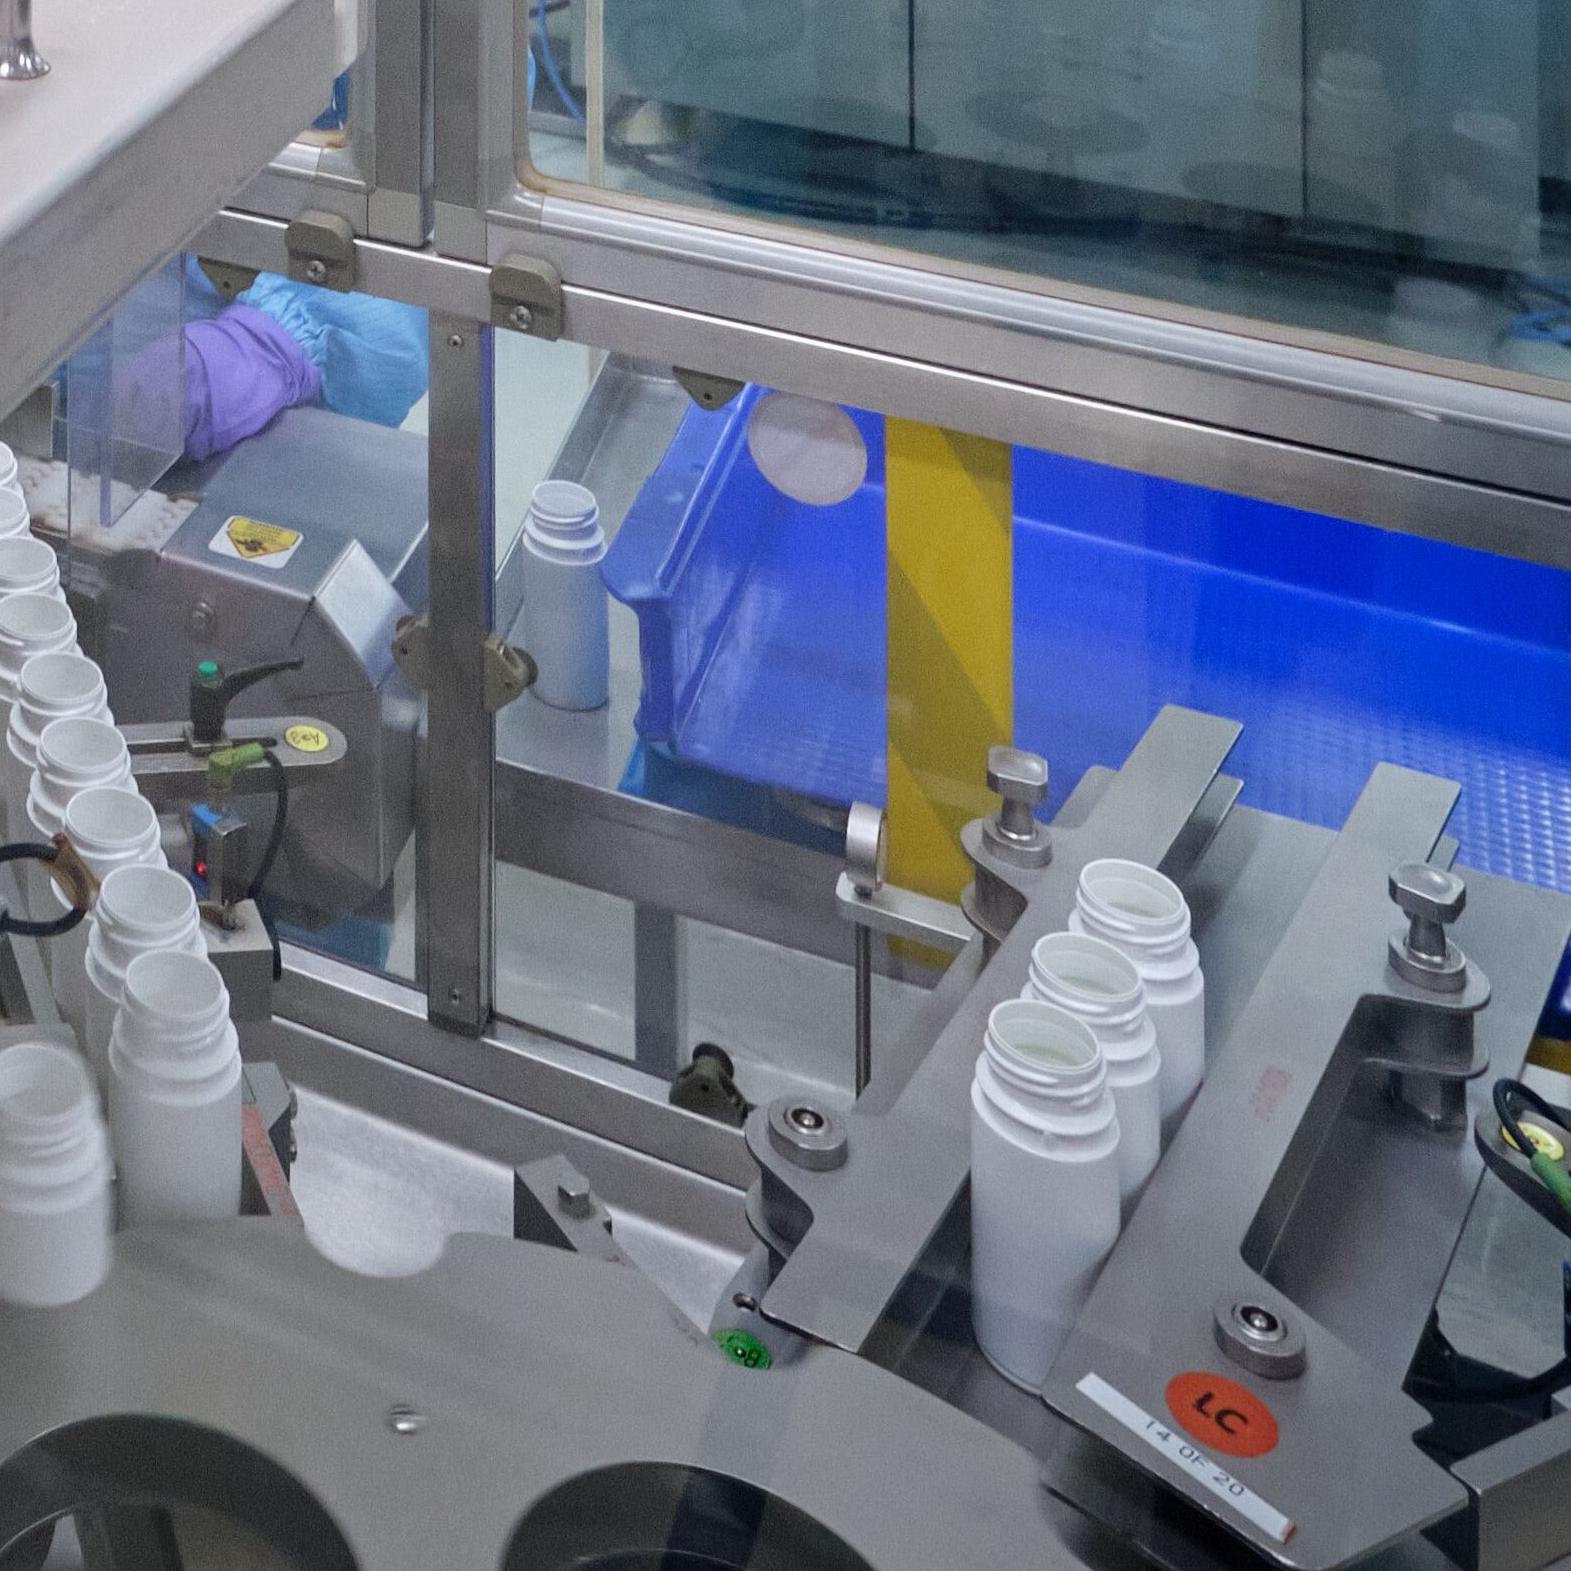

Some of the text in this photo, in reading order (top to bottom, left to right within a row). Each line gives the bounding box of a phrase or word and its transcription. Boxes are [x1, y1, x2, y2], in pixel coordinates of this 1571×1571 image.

[1193, 1391, 1249, 1435] LC
[1178, 1445, 1207, 1468] OF
[1212, 1470, 1245, 1497] 20
